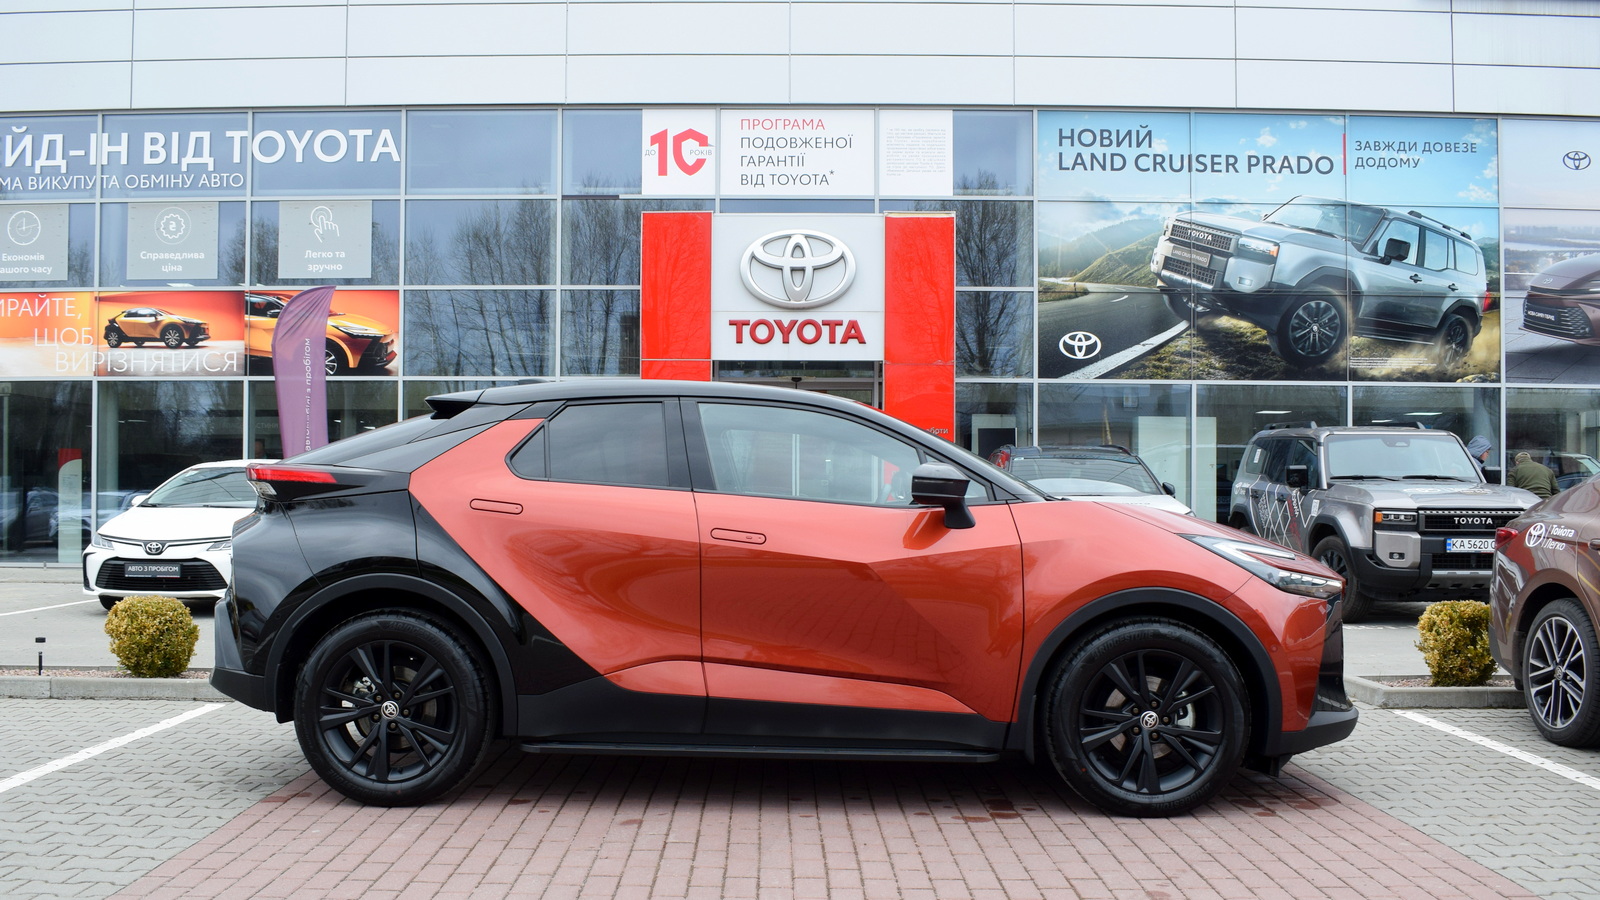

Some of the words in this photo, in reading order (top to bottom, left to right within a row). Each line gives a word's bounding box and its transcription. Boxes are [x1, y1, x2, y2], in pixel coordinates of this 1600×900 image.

[740, 118, 825, 130] ПРОГРАМА
[740, 134, 854, 151] ПОДОВЖЕНОЇ
[1058, 124, 1153, 148] НОВИЙ
[143, 131, 214, 172] ВІД
[225, 129, 401, 164] TOYOTA
[1355, 140, 1418, 154] ЗАВЖДИ
[1421, 142, 1477, 155] ДОВЕЗЕ
[740, 152, 806, 167] ГАРАНТІЇ
[1058, 152, 1127, 171] LAND
[1134, 153, 1239, 174] CRUISER
[1247, 155, 1334, 175] PRADO
[1355, 157, 1420, 170] ДОДОМУ
[28, 175, 97, 190] ВИКУПУ
[101, 174, 120, 189] ТА
[125, 173, 194, 189] ОБМІНУ
[198, 173, 244, 188] АВТО
[740, 174, 765, 188] ВІД
[1188, 230, 1212, 241] TOYOTA
[2, 253, 45, 262] Економія
[140, 251, 205, 261] Справедлива
[304, 250, 333, 259] Легко
[335, 251, 346, 259] та
[31, 266, 52, 275] часу
[161, 263, 182, 273] ціна
[307, 263, 343, 273] зручно
[34, 327, 94, 349] ЩОБ
[728, 318, 867, 345] TOYOTA
[55, 351, 237, 372] ВИРІЗНЯТИСЯ
[303, 338, 312, 386] пробігом
[1550, 524, 1575, 537] Тойота
[1452, 540, 1465, 549] KA
[1467, 540, 1489, 549] 5620
[1543, 538, 1566, 551] Легко
[148, 565, 179, 573] ПРОБІГОМ
